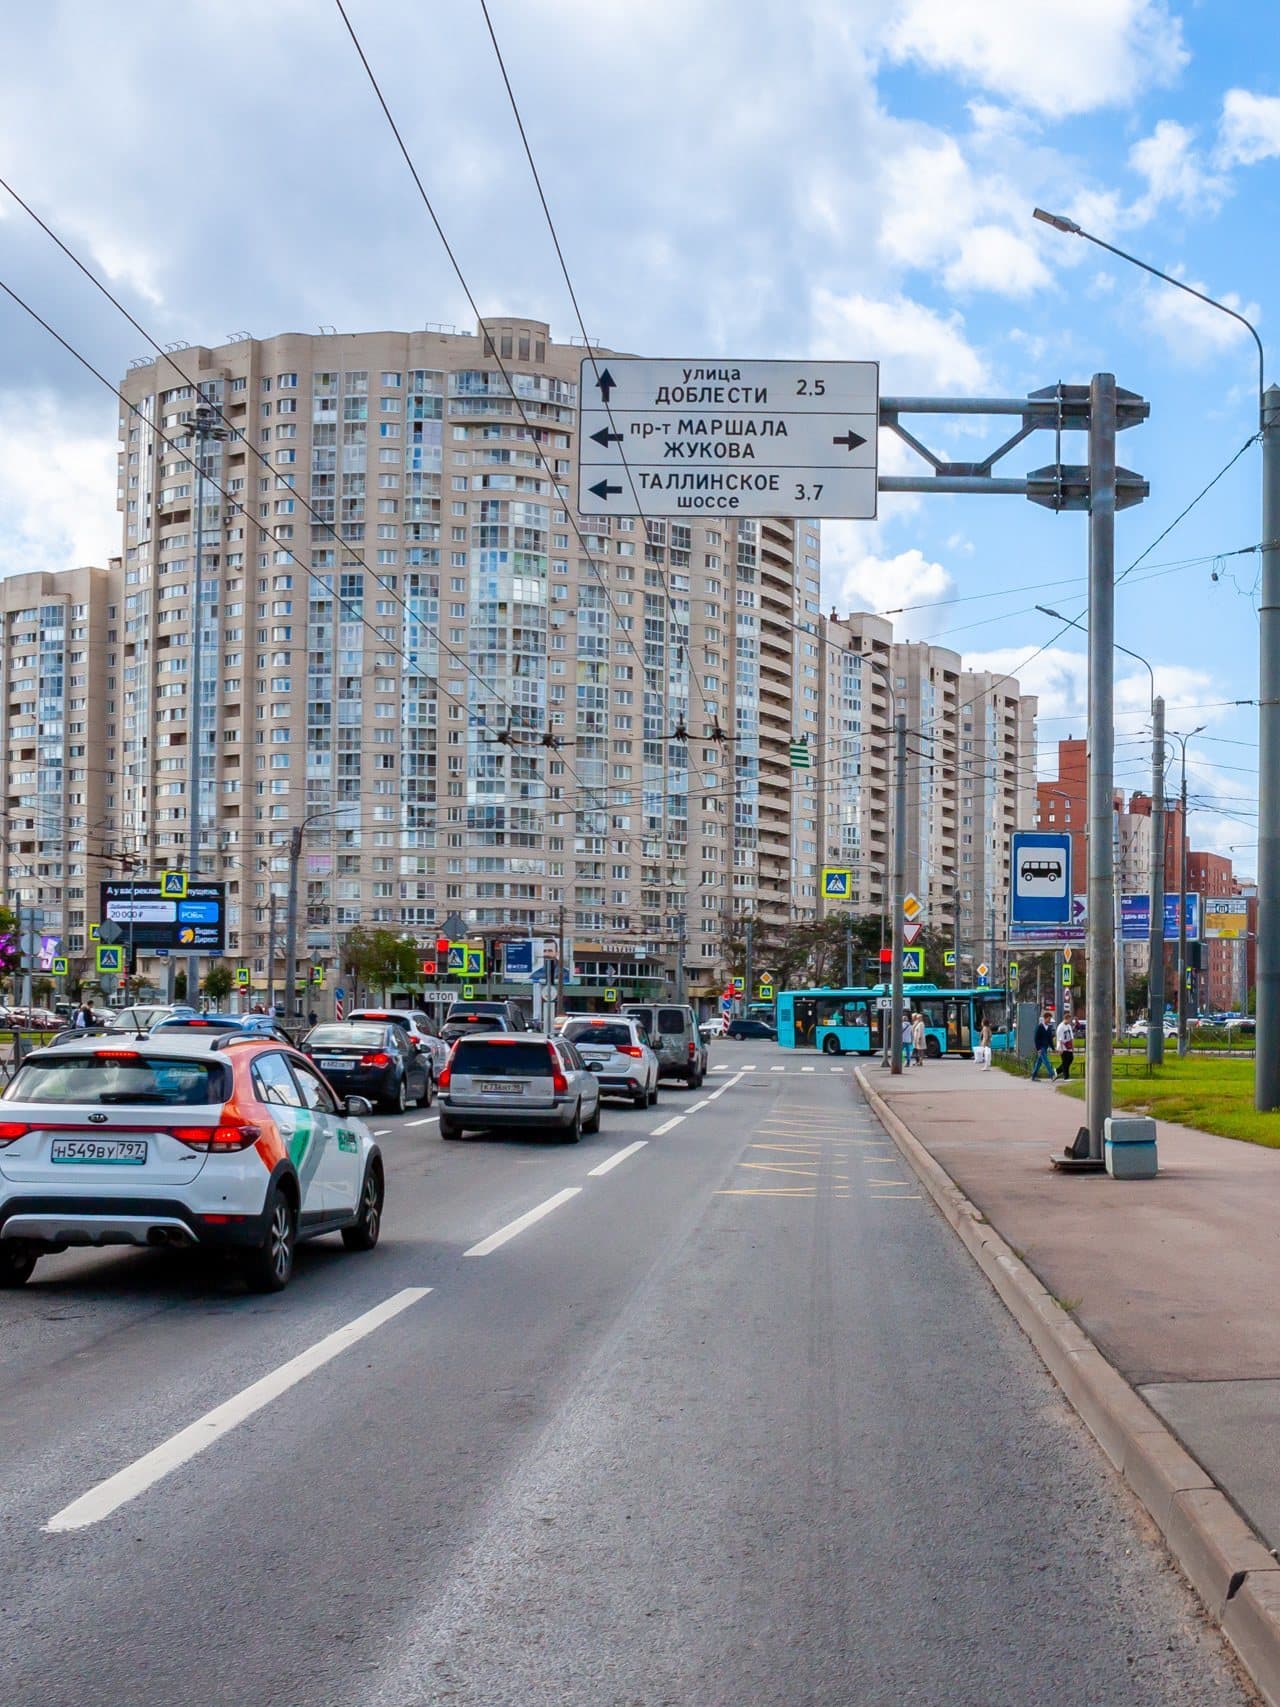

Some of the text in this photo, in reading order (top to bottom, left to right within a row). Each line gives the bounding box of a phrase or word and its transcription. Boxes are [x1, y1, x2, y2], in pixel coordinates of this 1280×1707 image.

[682, 369, 742, 384] улица
[655, 386, 768, 405] ДОБЛЕСТИ
[630, 419, 788, 439] пр-т МАРШАЛА
[663, 441, 755, 459] ЖУКОВА
[639, 473, 780, 491] ТАЛЛИНСКОЕ
[677, 496, 740, 508] шоссе
[429, 992, 454, 1001] СТОП
